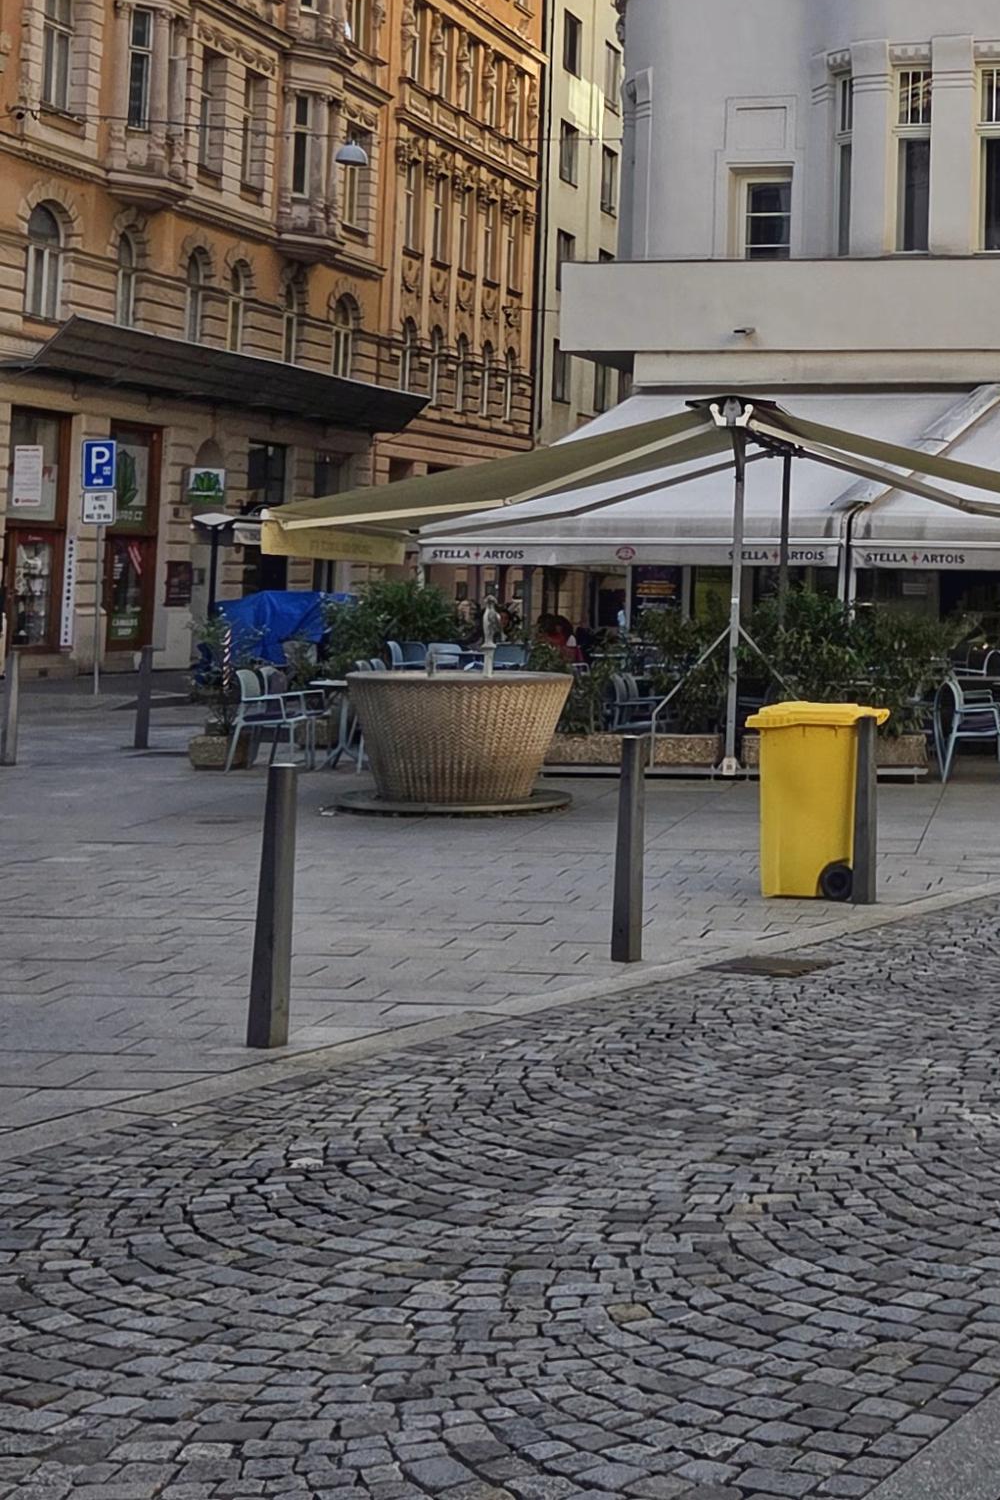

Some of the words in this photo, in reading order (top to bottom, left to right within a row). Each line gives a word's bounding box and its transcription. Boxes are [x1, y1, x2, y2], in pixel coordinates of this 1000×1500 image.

[91, 446, 110, 475] P
[432, 549, 470, 559] STELLA
[483, 549, 524, 560] ARTOIS
[728, 550, 769, 561] SELLA
[865, 552, 908, 563] STELLA
[921, 553, 966, 565] ARTOIS
